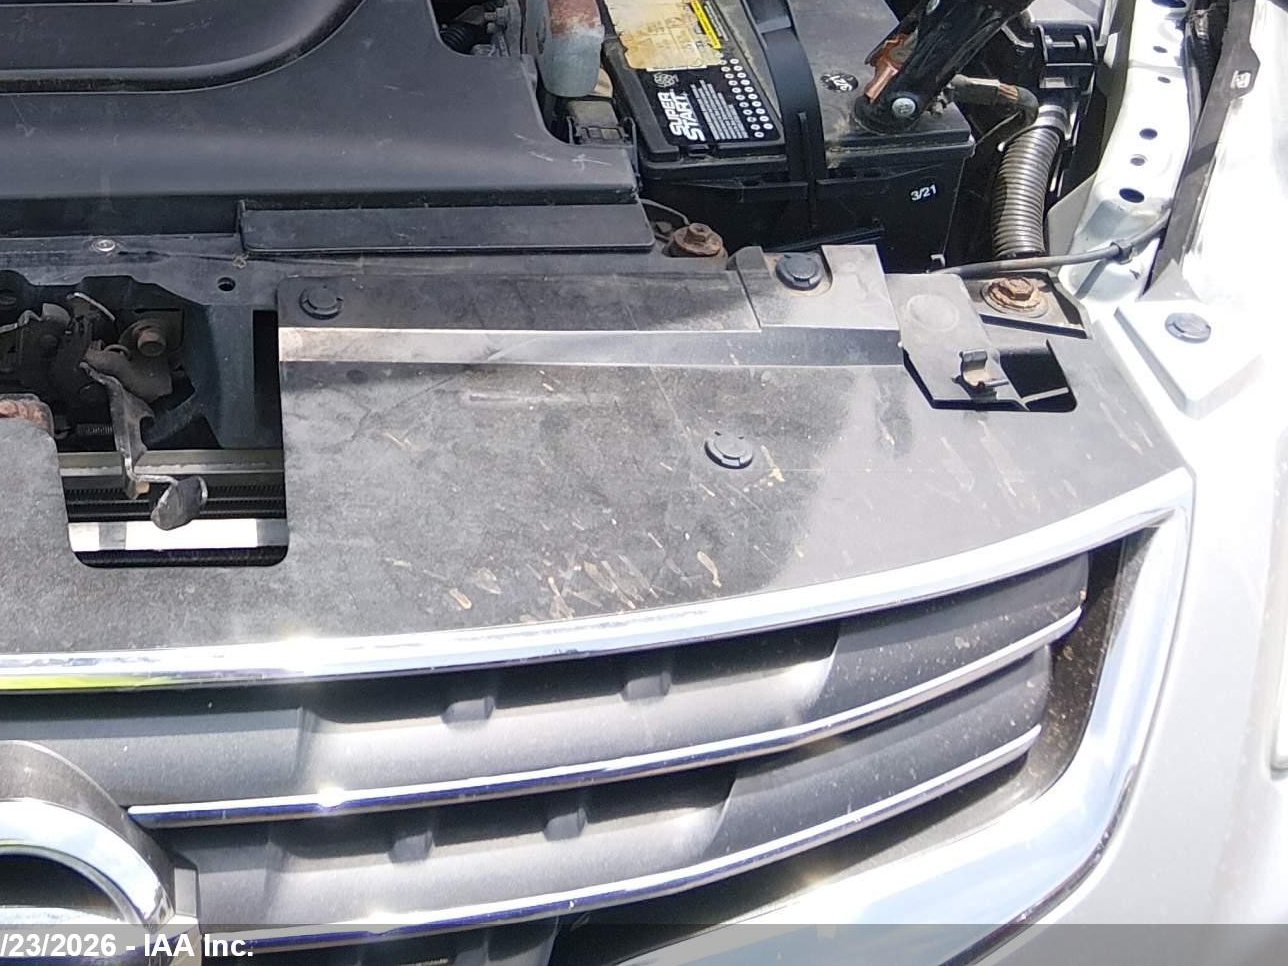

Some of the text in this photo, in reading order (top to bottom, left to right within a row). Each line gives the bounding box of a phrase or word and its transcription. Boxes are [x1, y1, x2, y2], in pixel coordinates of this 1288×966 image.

[657, 91, 683, 136] SUPER
[670, 89, 706, 142] START
[910, 184, 937, 201] 3/21
